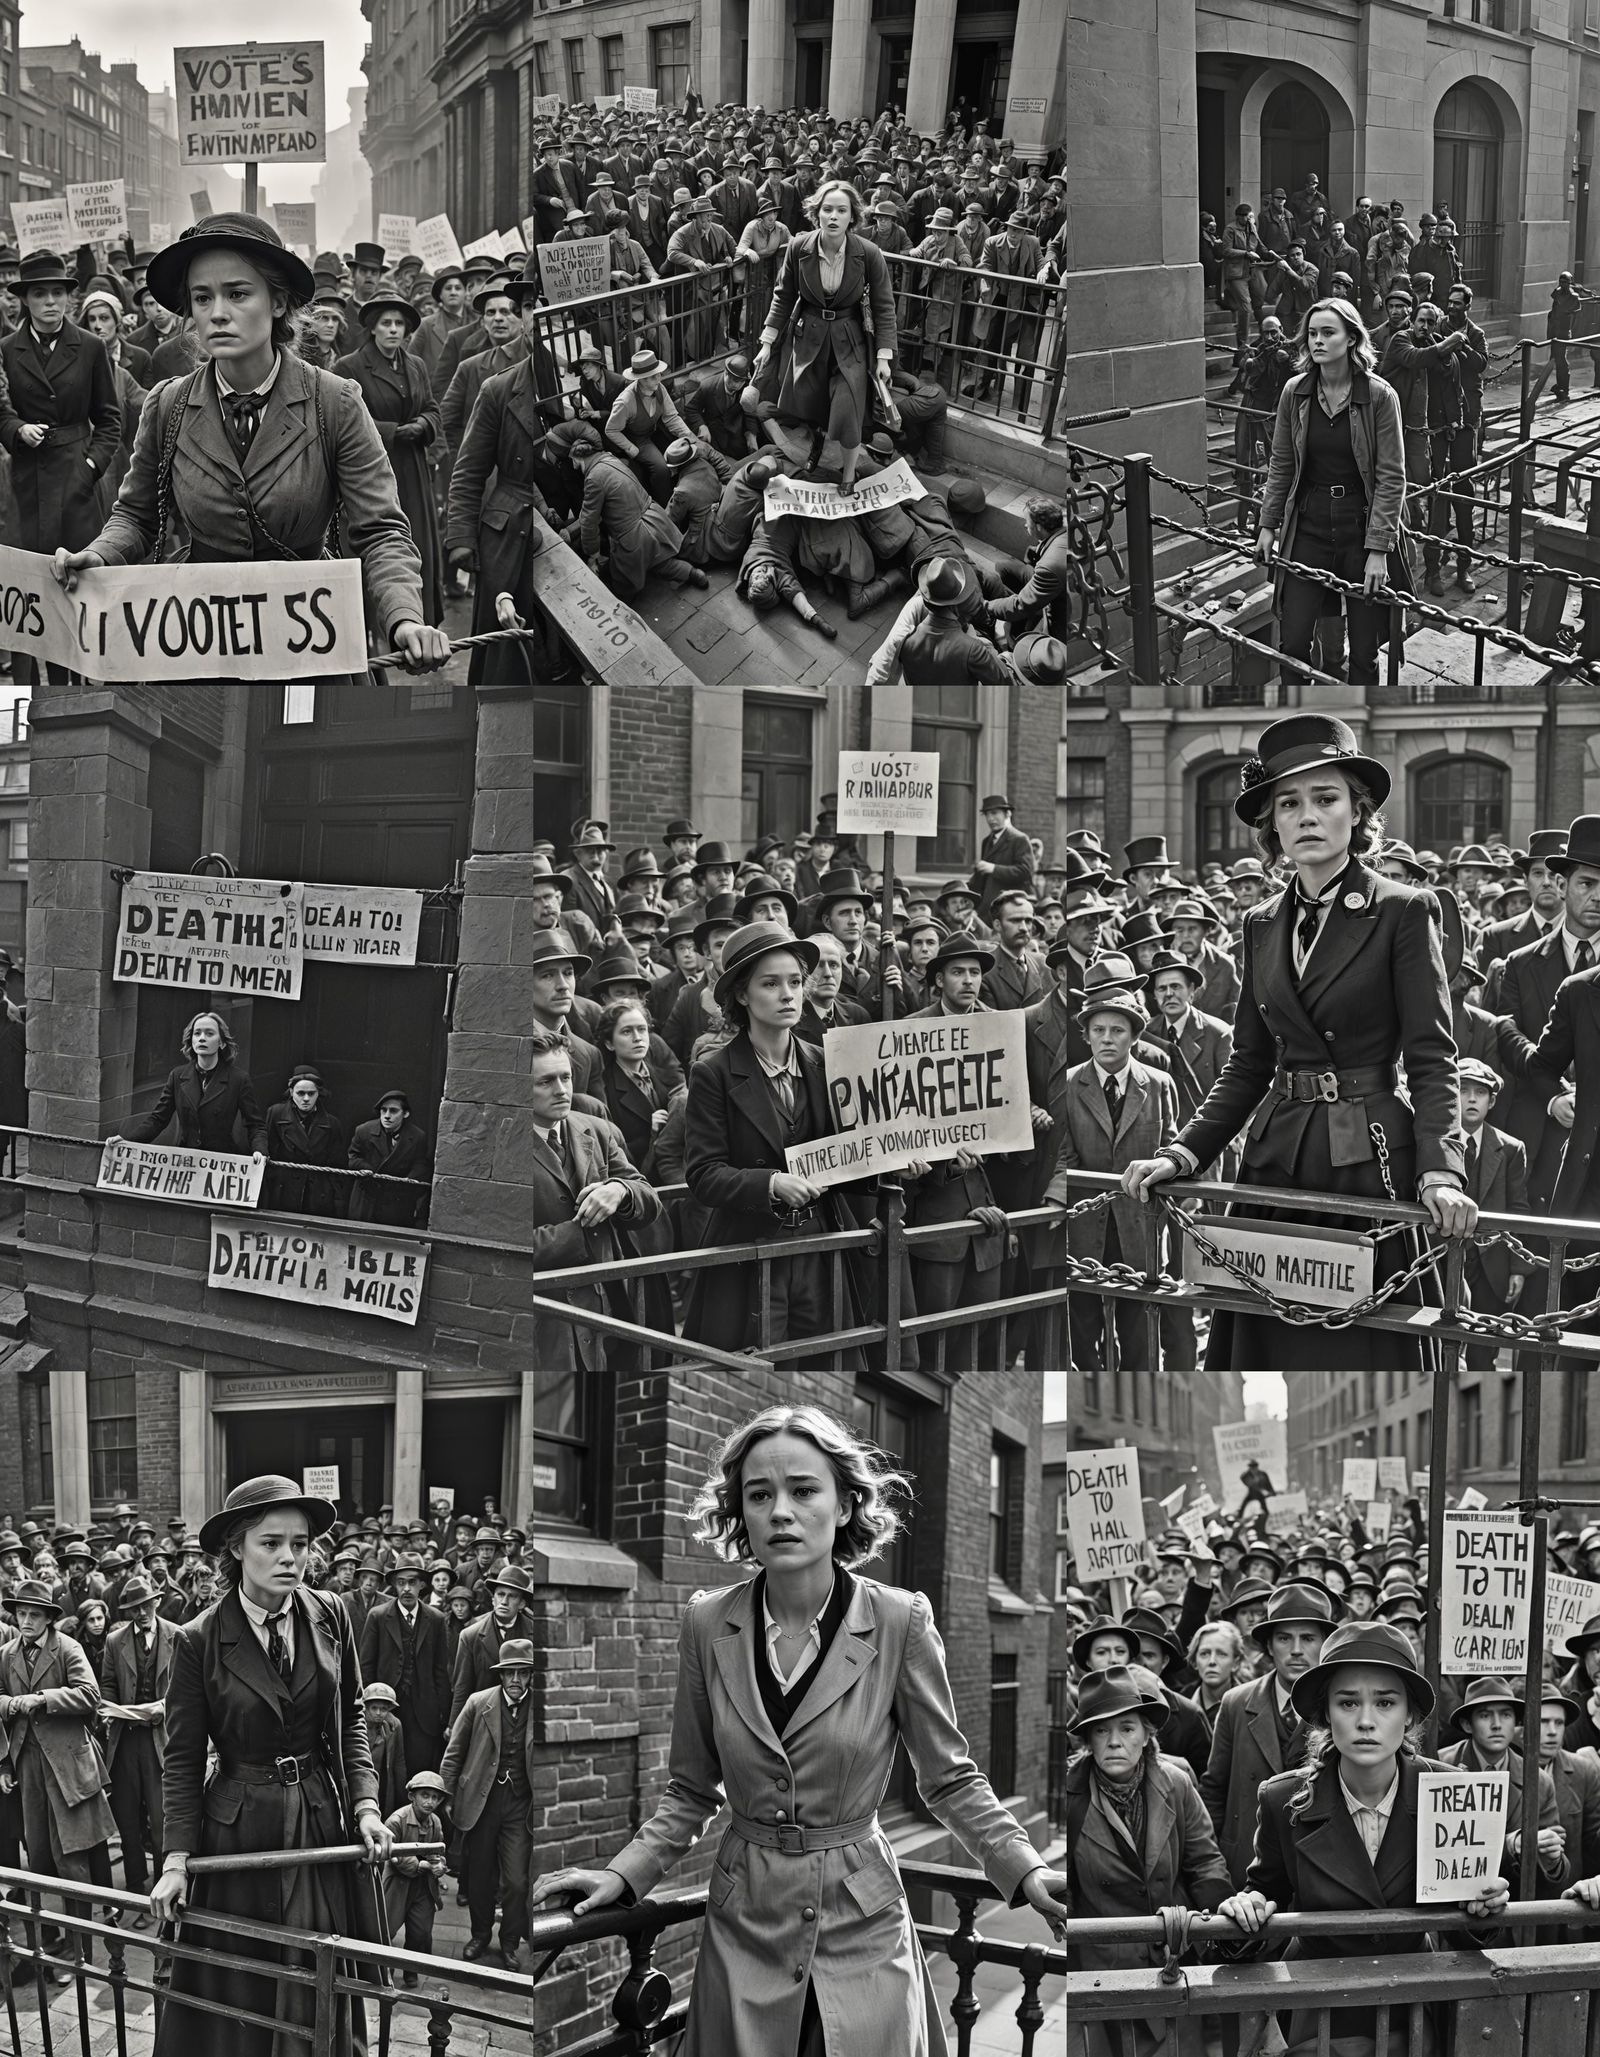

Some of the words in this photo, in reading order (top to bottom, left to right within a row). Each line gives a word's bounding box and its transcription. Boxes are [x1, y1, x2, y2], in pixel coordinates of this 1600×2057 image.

[1067, 1464, 1128, 1497] DEATH
[1088, 1491, 1114, 1516] TO
[1456, 1529, 1528, 1562] DEATH
[1494, 1566, 1526, 1600] TH
[1428, 1782, 1503, 1813] TREATH
[1435, 1819, 1486, 1849] DAL
